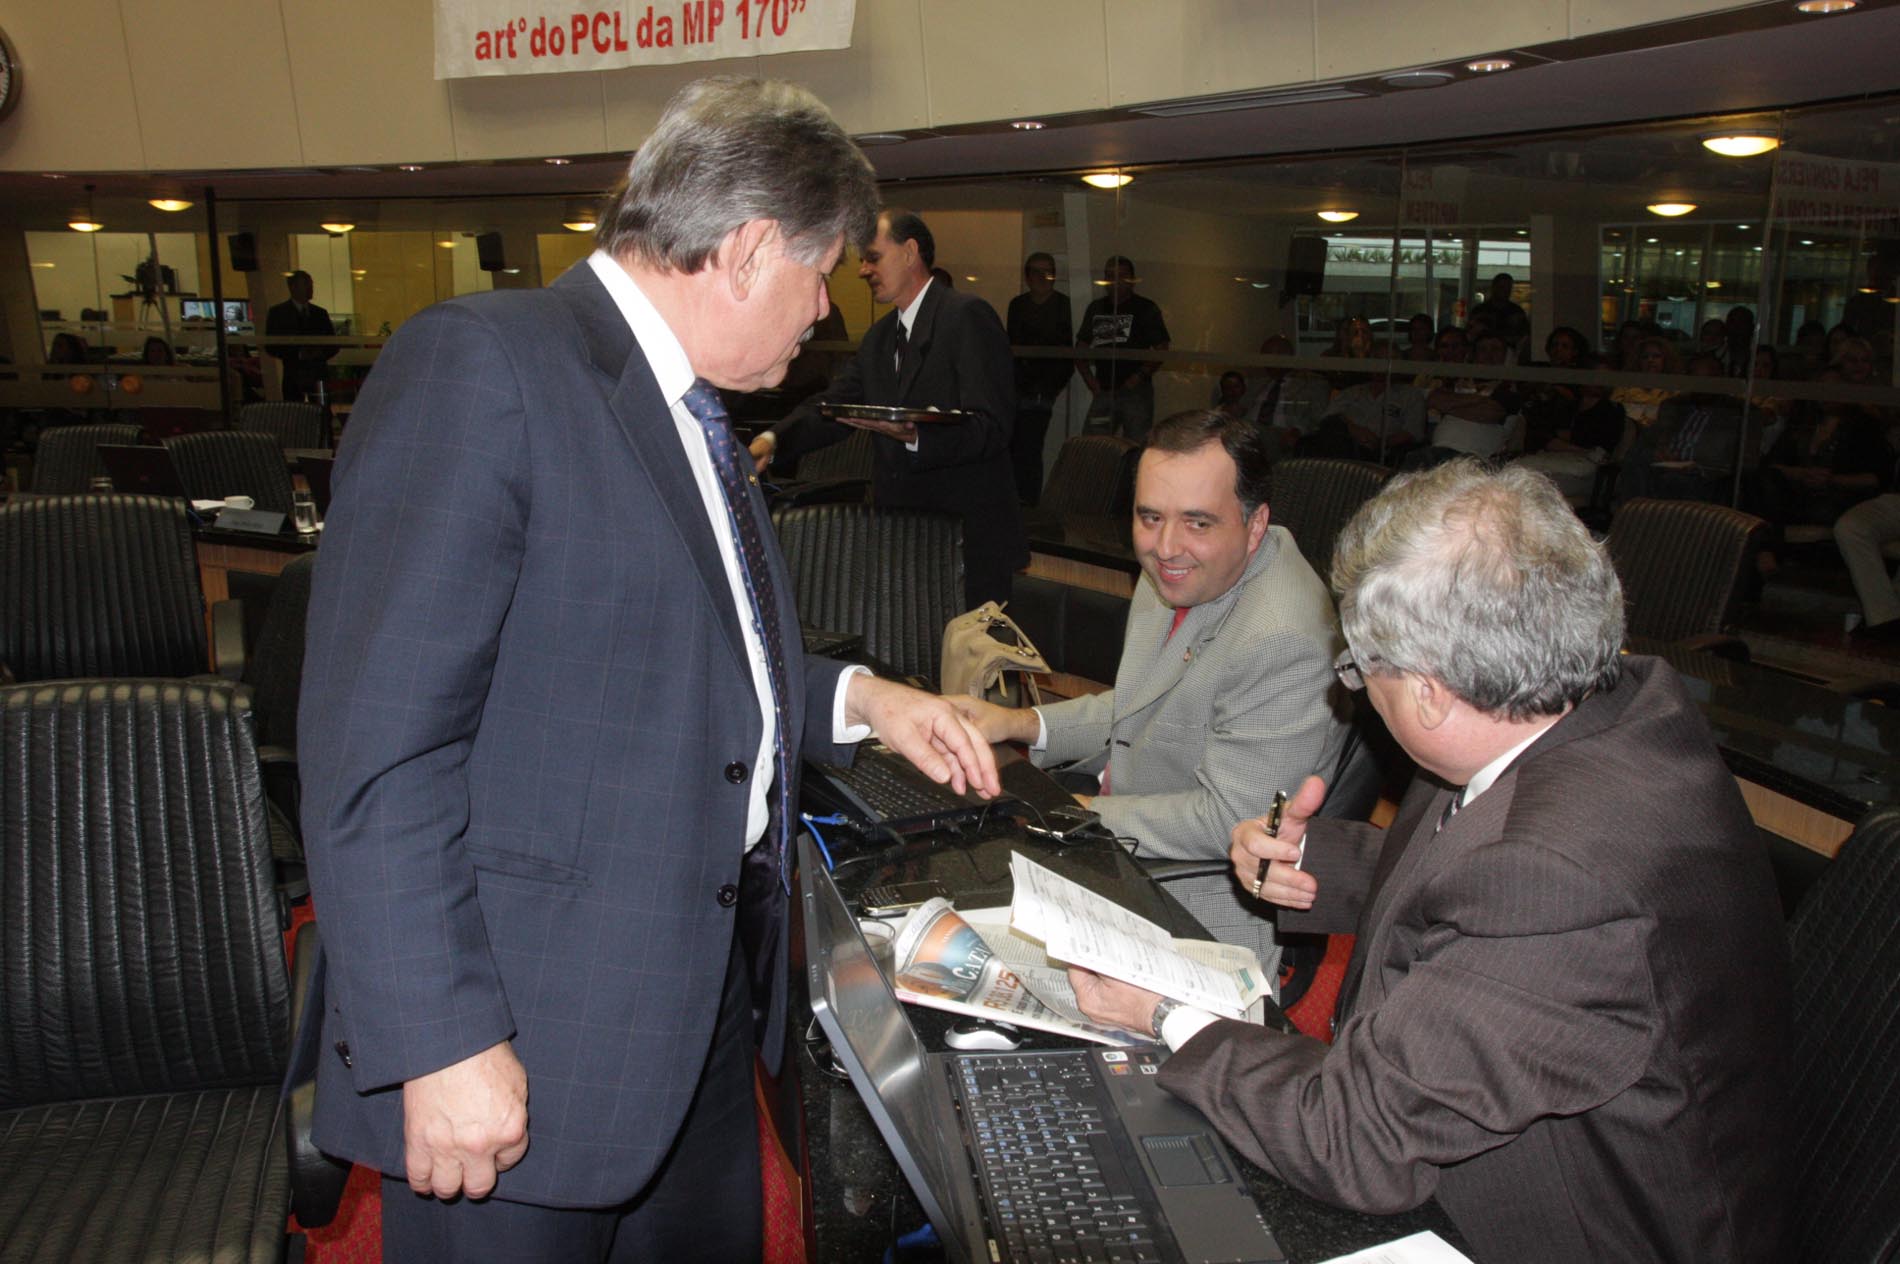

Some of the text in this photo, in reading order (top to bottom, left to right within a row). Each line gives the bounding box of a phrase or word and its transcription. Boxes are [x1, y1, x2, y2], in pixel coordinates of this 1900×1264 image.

[530, 16, 566, 58] do
[571, 11, 629, 55] PCL
[636, 6, 674, 48] da
[682, 0, 724, 45] MP
